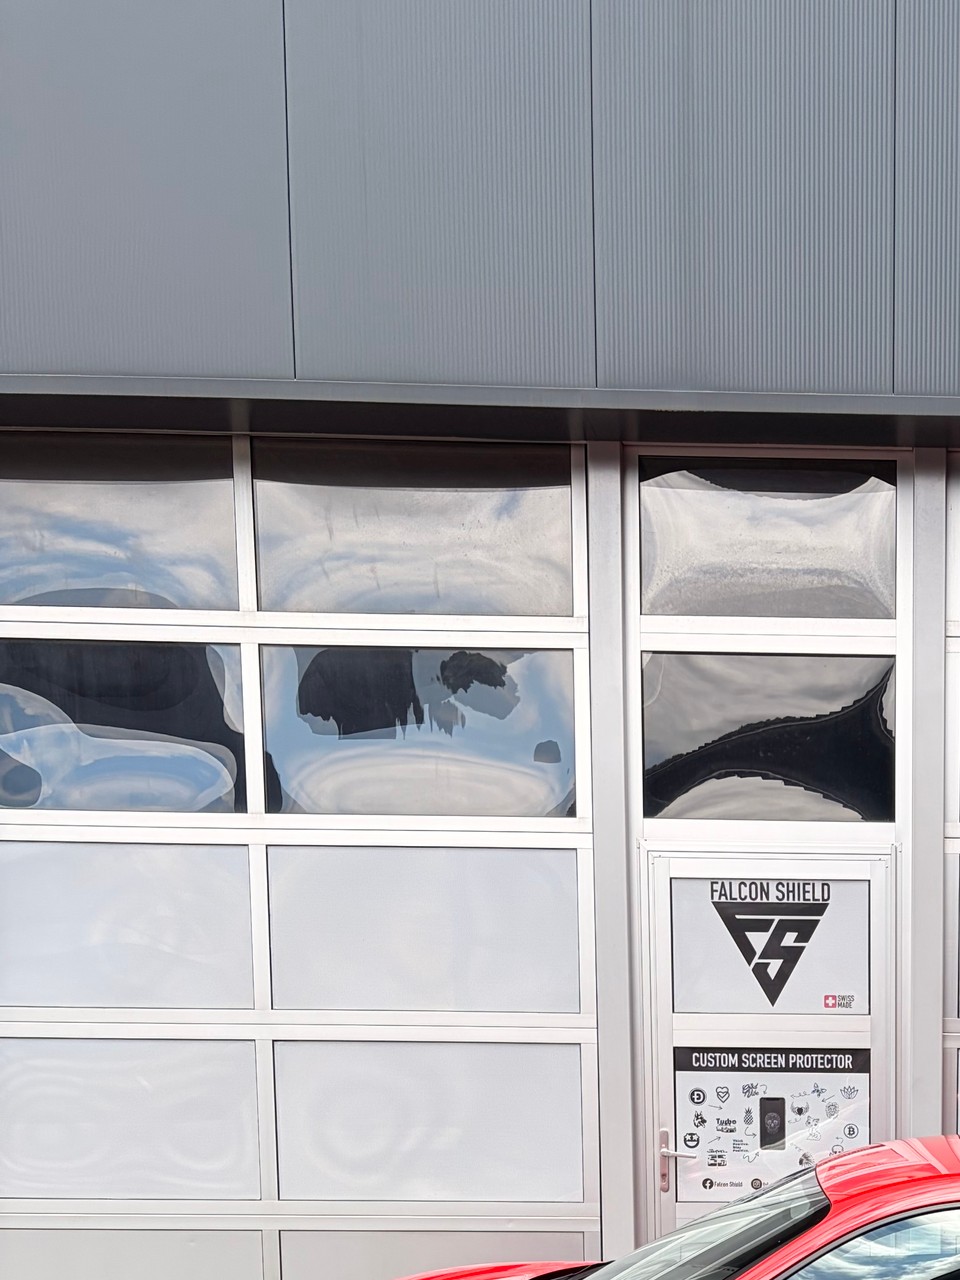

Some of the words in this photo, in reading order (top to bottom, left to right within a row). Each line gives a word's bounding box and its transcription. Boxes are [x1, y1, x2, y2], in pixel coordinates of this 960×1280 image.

[710, 881, 770, 901] FALCON
[775, 882, 831, 902] SHIELD
[837, 994, 855, 1002] SWISS
[692, 1053, 738, 1067] CUSTOM
[742, 1053, 786, 1068] SCREEN
[789, 1054, 853, 1069] PROTECTOR
